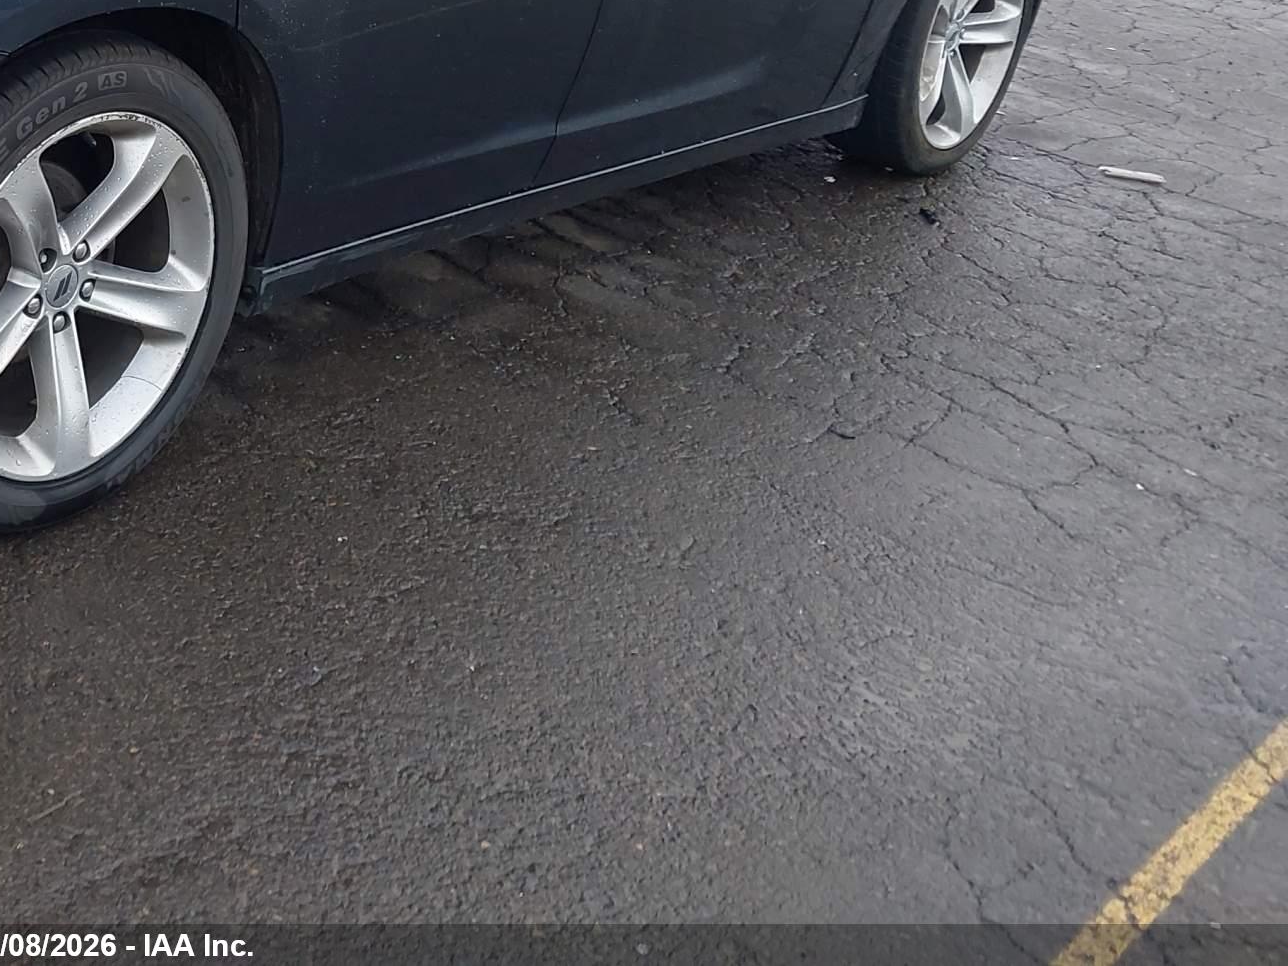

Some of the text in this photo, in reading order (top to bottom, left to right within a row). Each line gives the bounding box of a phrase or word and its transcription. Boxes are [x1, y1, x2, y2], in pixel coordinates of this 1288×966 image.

[16, 96, 66, 139] Gen
[73, 82, 88, 104] 2
[100, 71, 126, 89] AS
